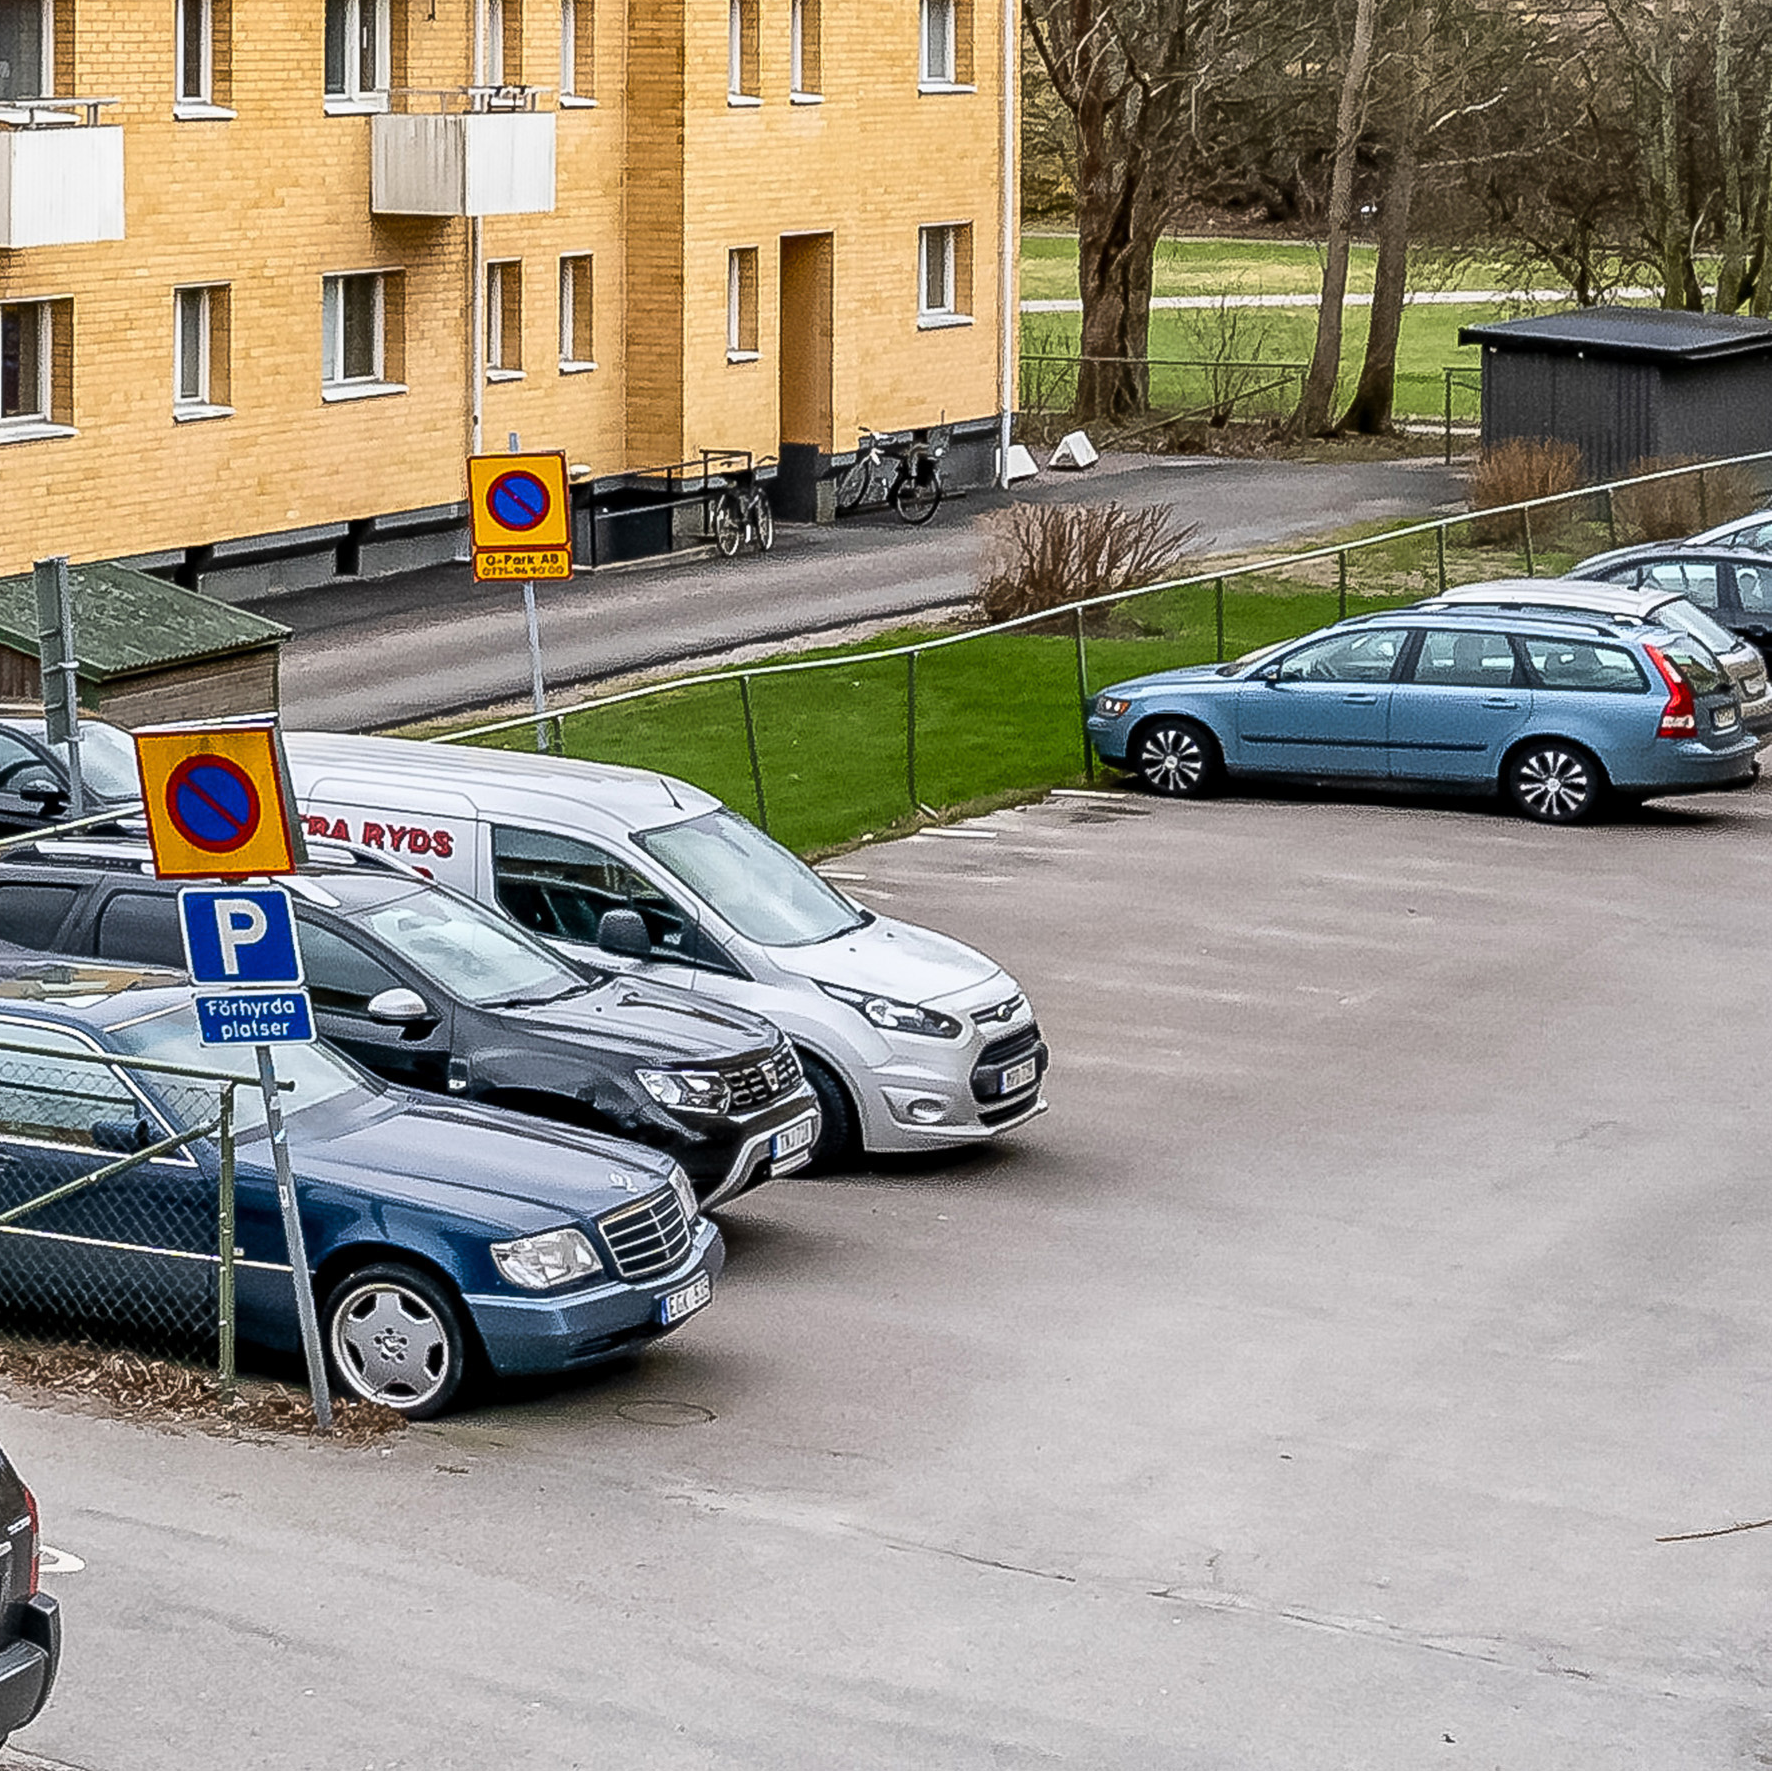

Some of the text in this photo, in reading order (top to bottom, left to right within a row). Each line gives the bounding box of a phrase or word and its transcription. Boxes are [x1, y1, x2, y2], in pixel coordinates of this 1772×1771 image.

[540, 553, 559, 564] AB
[299, 814, 454, 858] RA RYDS
[213, 898, 268, 976] P
[205, 998, 296, 1019] Förhyrda
[221, 1020, 290, 1040] platser
